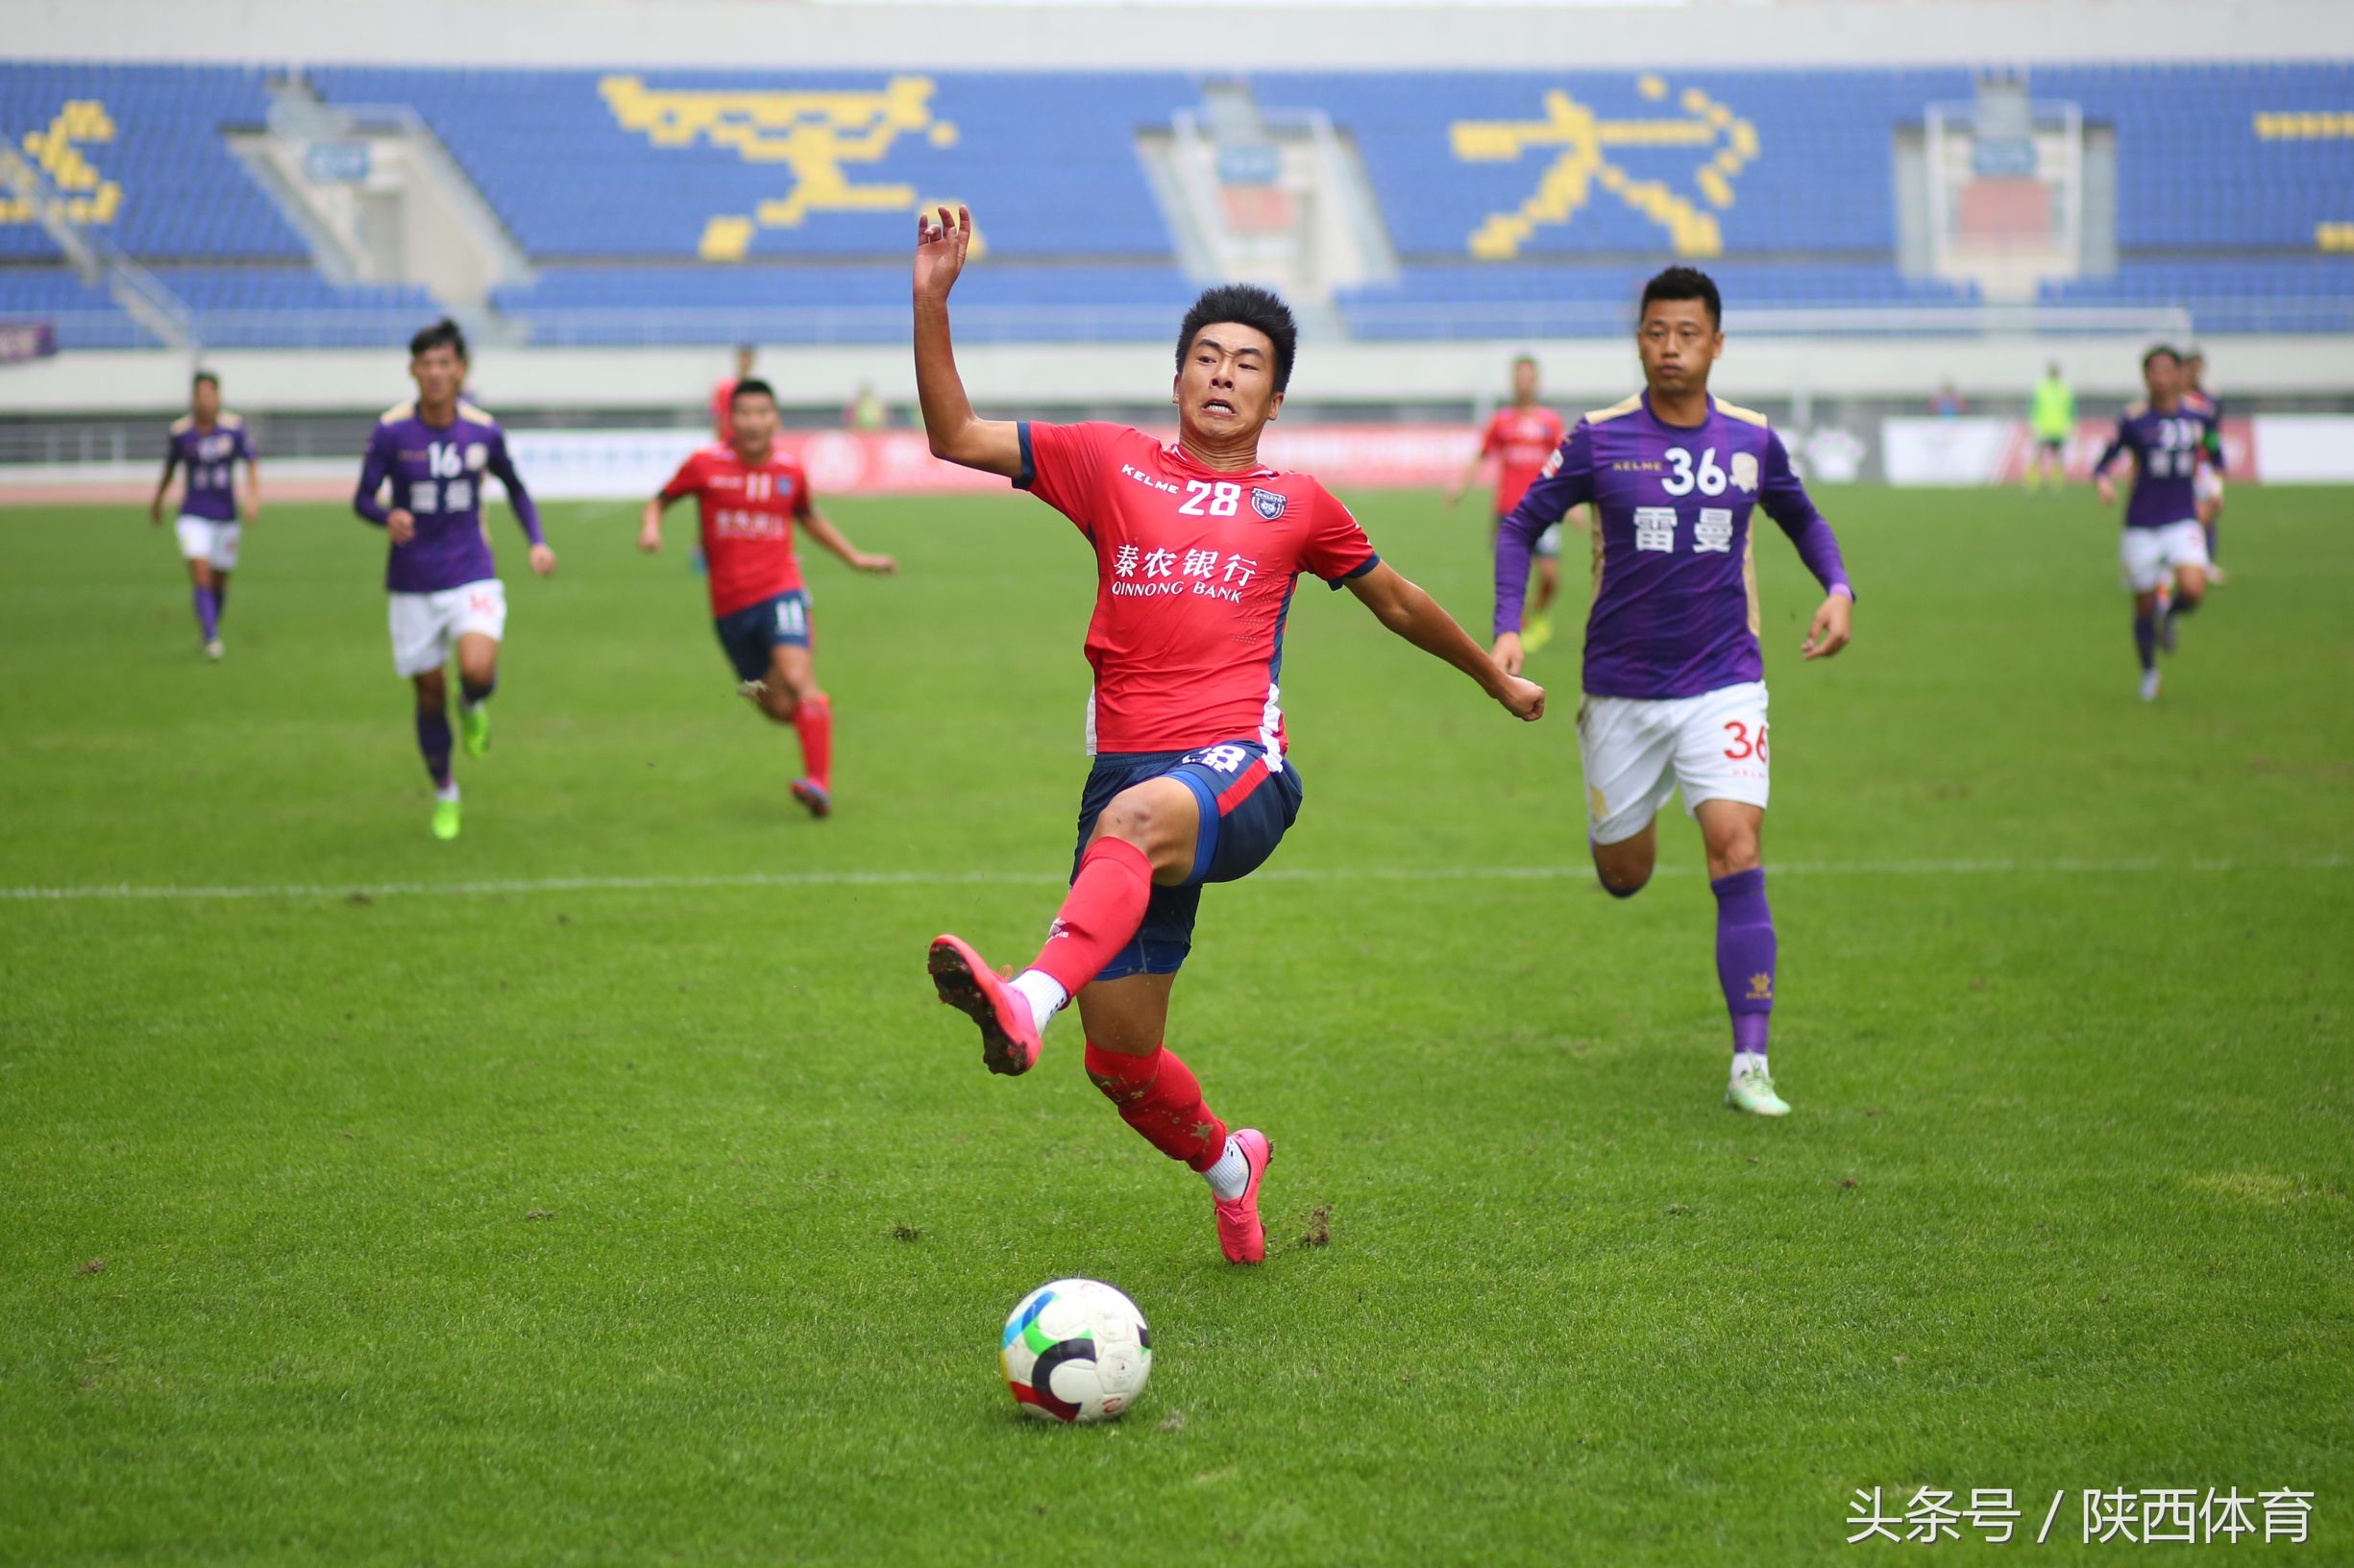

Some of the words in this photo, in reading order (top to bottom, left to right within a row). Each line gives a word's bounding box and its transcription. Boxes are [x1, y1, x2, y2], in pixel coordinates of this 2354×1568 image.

[428, 441, 463, 478] 16
[1661, 447, 1728, 497] 36
[745, 472, 772, 502] 11
[1121, 463, 1179, 494] KELME
[1179, 480, 1241, 516] 28
[1633, 506, 1734, 553] 雷曼
[1113, 544, 1257, 585] 秦农银行
[1111, 580, 1184, 597] QINNONG
[1192, 580, 1242, 603] BANK
